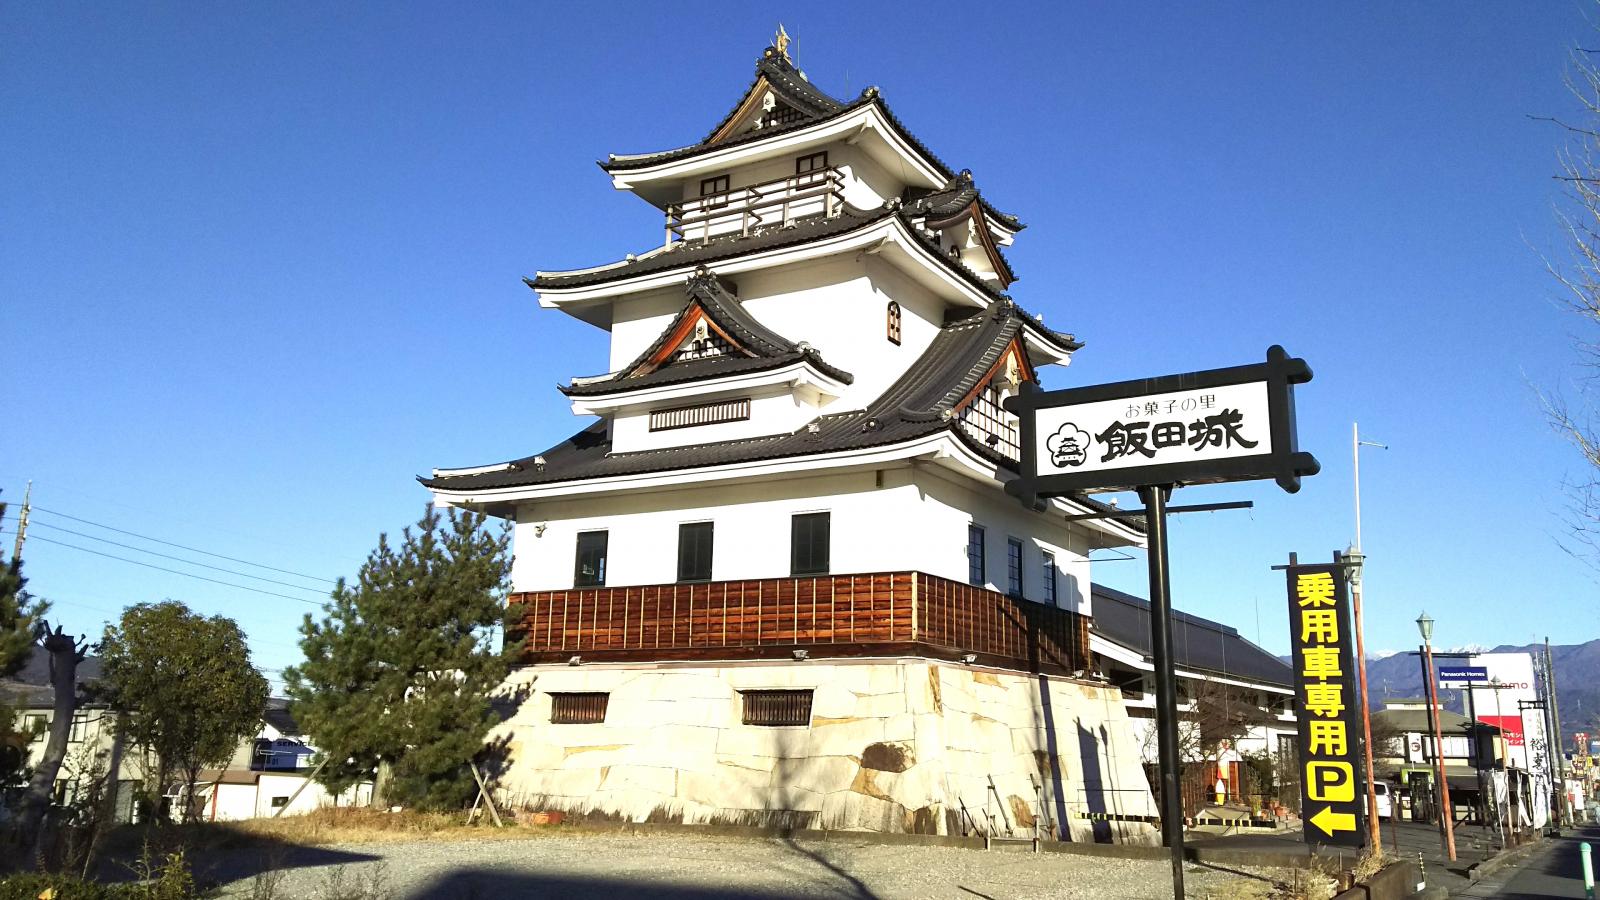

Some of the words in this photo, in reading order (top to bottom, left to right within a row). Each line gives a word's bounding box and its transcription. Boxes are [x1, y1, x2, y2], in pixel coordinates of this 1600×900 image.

[1125, 394, 1216, 419] お菓子の里
[1095, 408, 1258, 463] 飯田城
[1297, 572, 1348, 756] 乗用車専用
[1315, 765, 1347, 798] P
